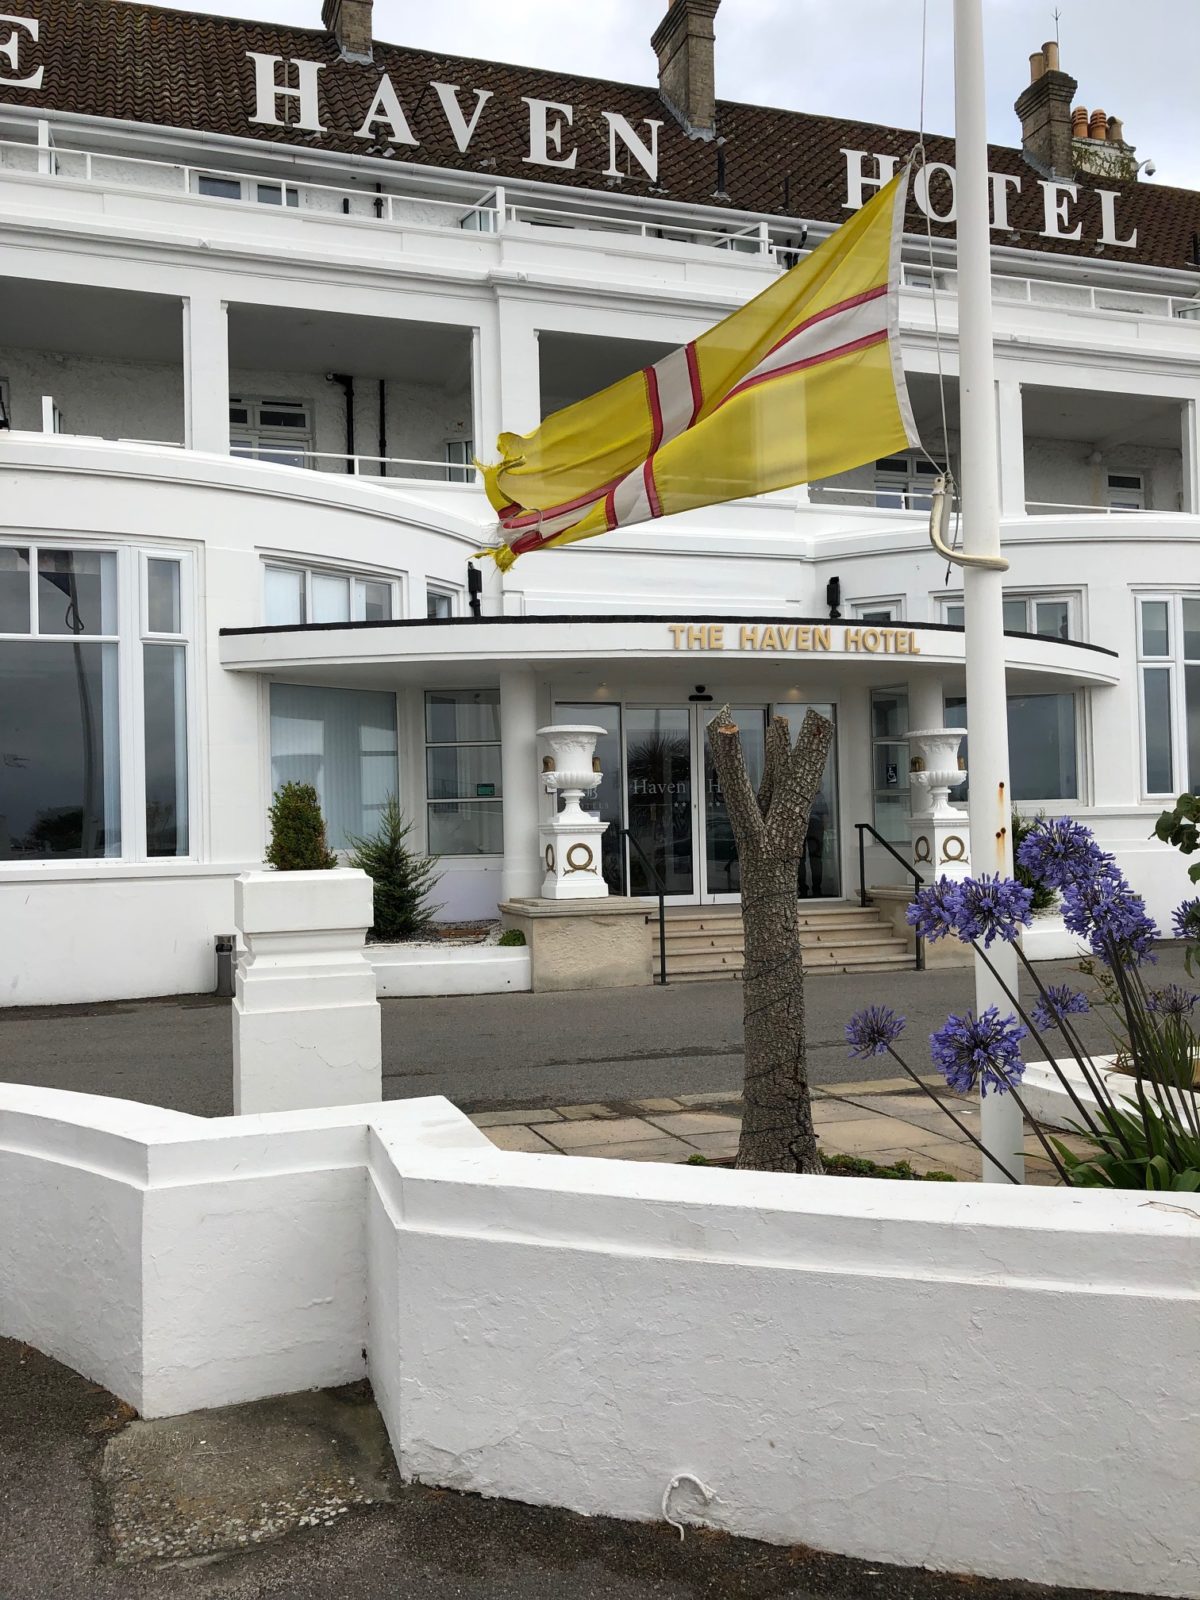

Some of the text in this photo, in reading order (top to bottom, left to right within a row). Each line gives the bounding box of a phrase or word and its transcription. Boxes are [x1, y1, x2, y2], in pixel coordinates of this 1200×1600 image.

[245, 51, 664, 182] HAVEN
[839, 148, 1138, 249] HOTEL
[668, 624, 921, 654] THE HAVEN HOTEL
[633, 779, 687, 795] Haven
